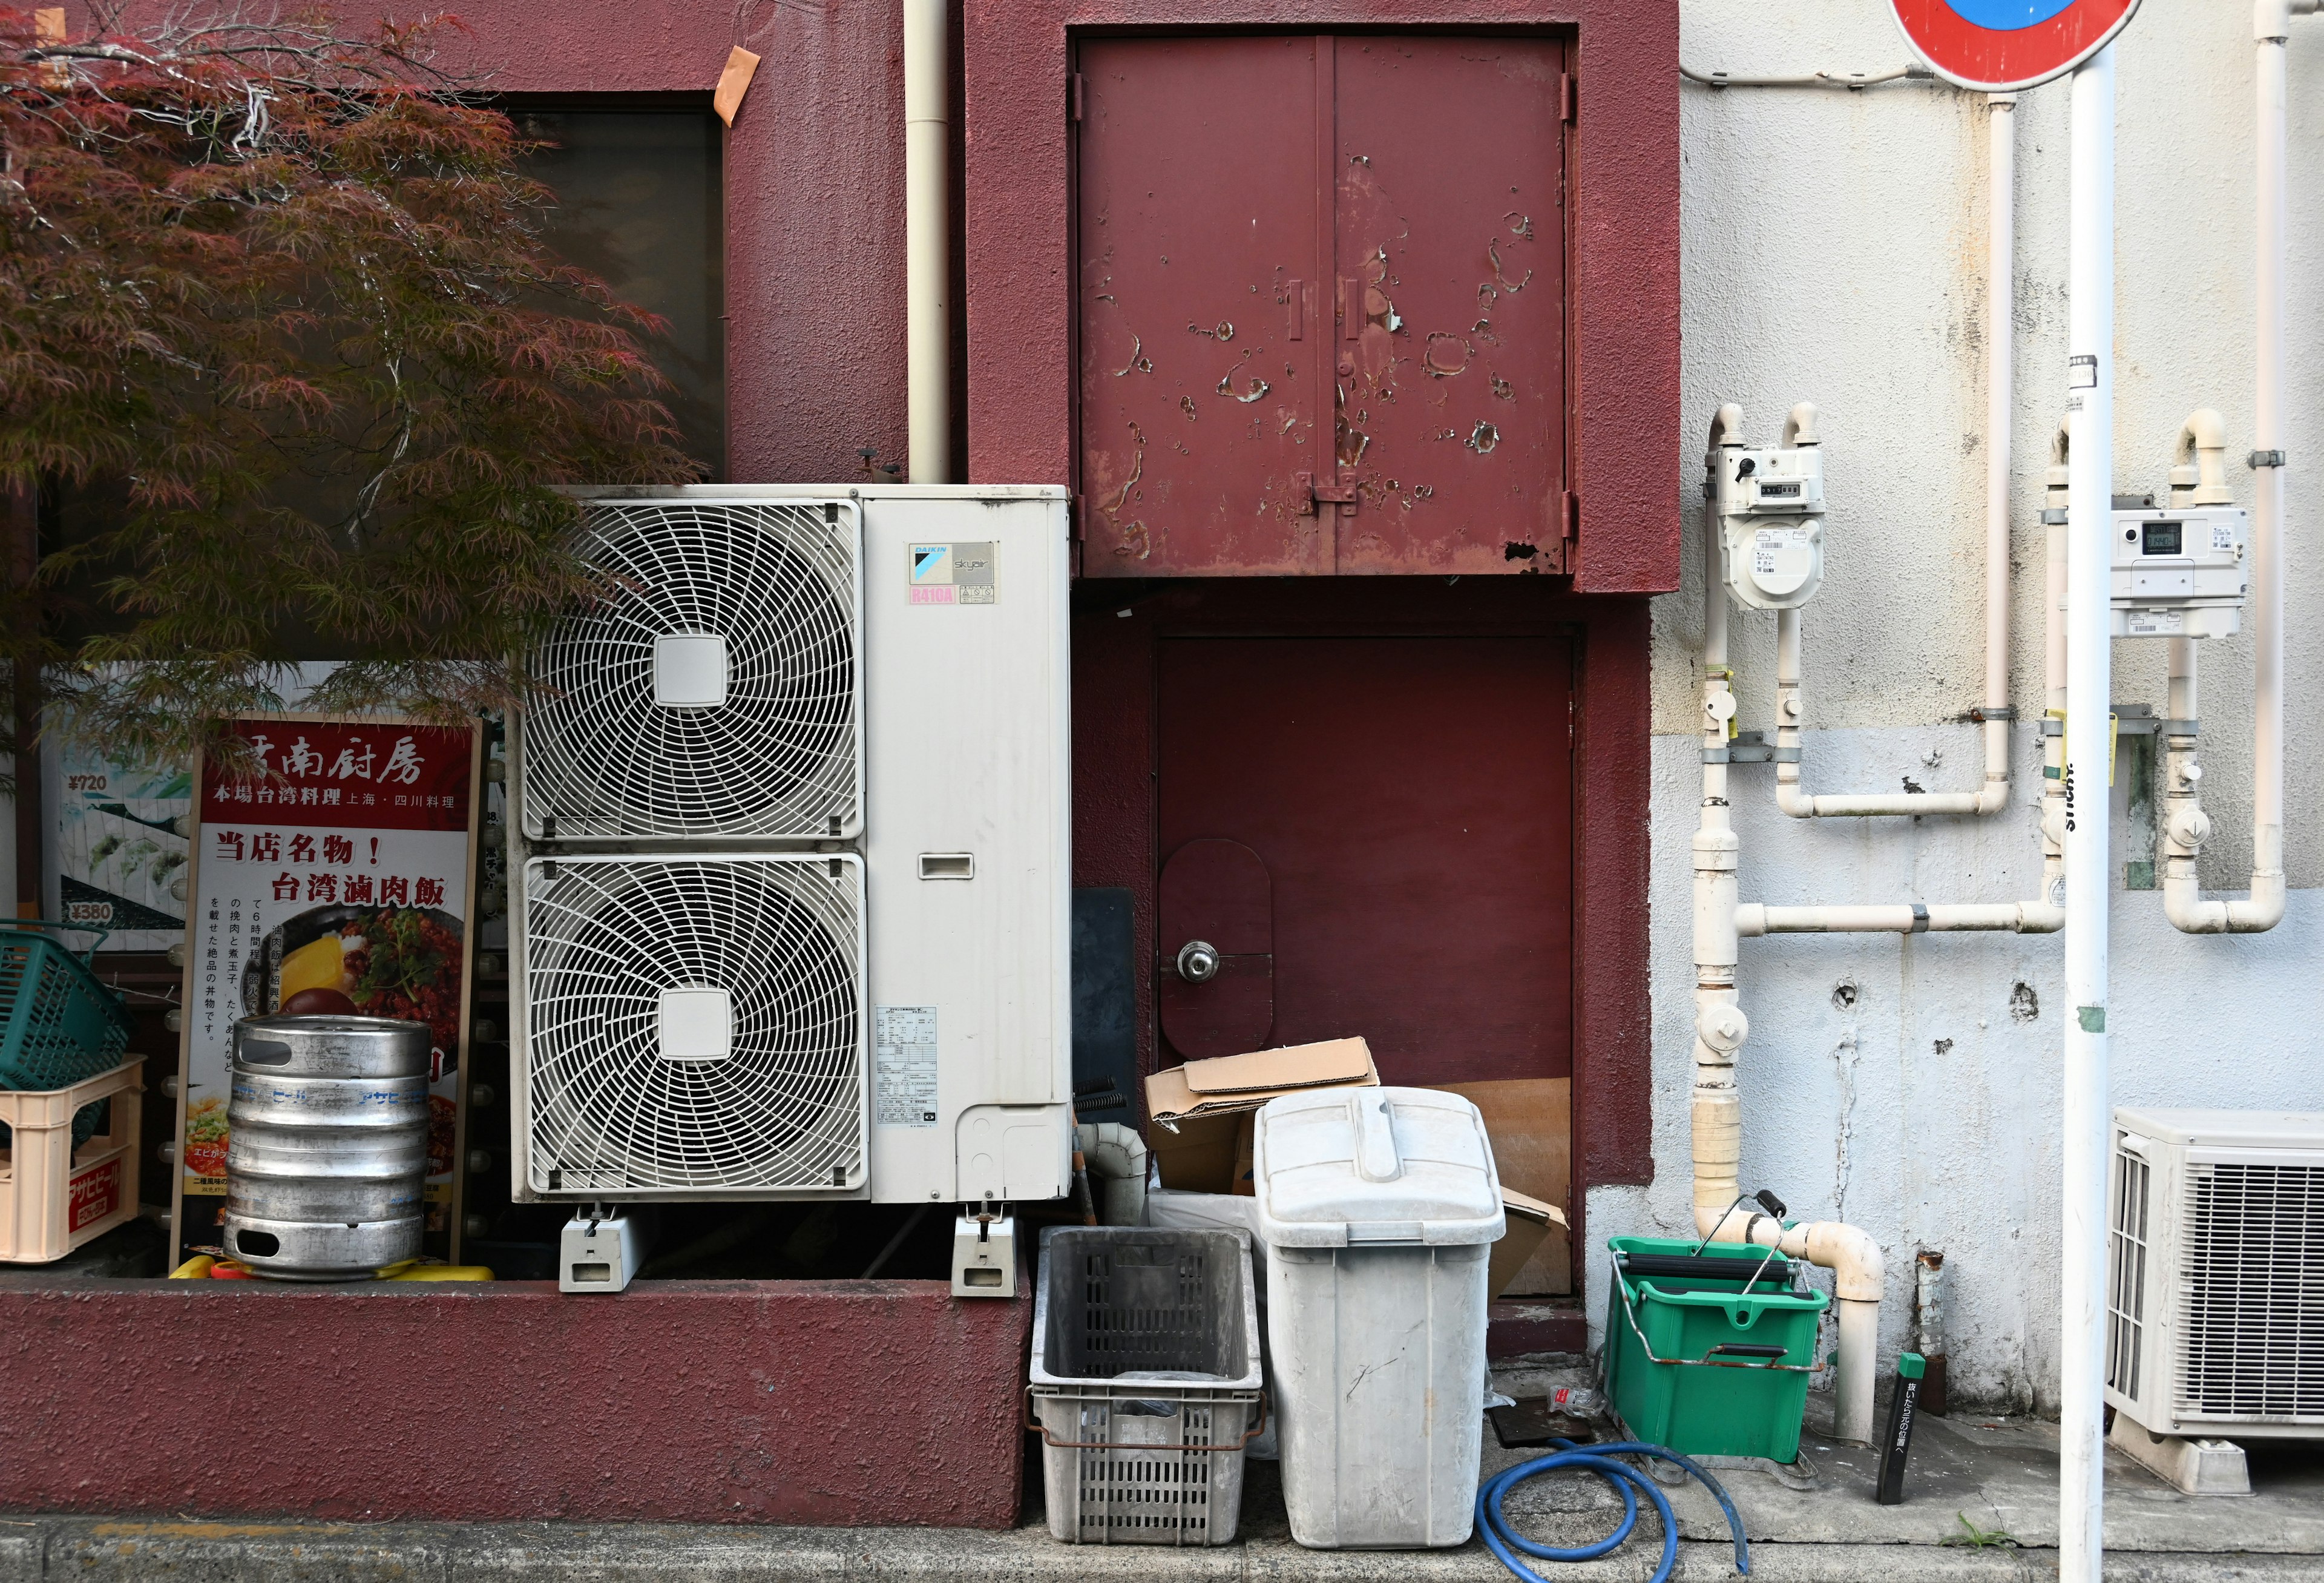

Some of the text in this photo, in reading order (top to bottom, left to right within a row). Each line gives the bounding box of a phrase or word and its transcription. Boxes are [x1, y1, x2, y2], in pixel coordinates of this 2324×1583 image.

[911, 588, 953, 602] R410A
[68, 775, 107, 791] ¥720
[213, 784, 455, 808] 本場台湾料理 上海・四川料理
[216, 831, 380, 866] 当店名物！
[272, 872, 445, 906] 台湾滷肉飯
[71, 904, 111, 920] ¥380
[204, 897, 219, 1041] を載せた絶品の丼物です。
[269, 924, 283, 1015] 滷肉飯は紹興酒
[69, 1164, 120, 1206] アサヒビール
[1895, 1383, 1917, 1454] 抜いたら元の位置へ
